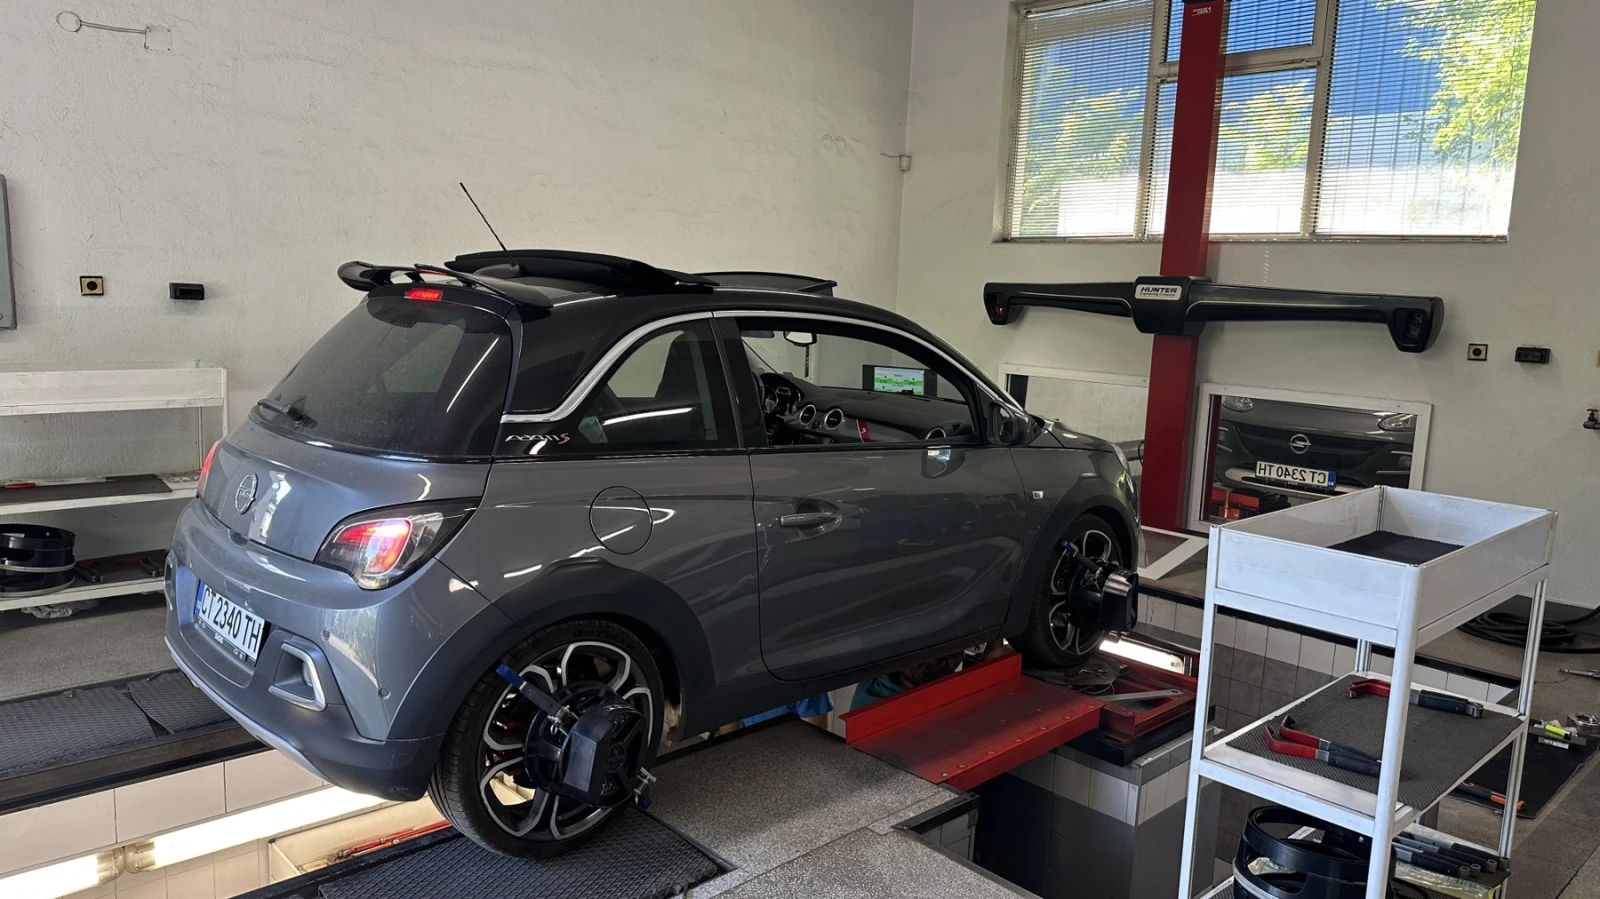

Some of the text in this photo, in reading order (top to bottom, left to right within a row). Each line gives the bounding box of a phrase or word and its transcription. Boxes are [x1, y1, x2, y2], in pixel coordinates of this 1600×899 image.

[1140, 286, 1178, 294] HUNTER
[201, 586, 262, 653] CT 2340 TH
